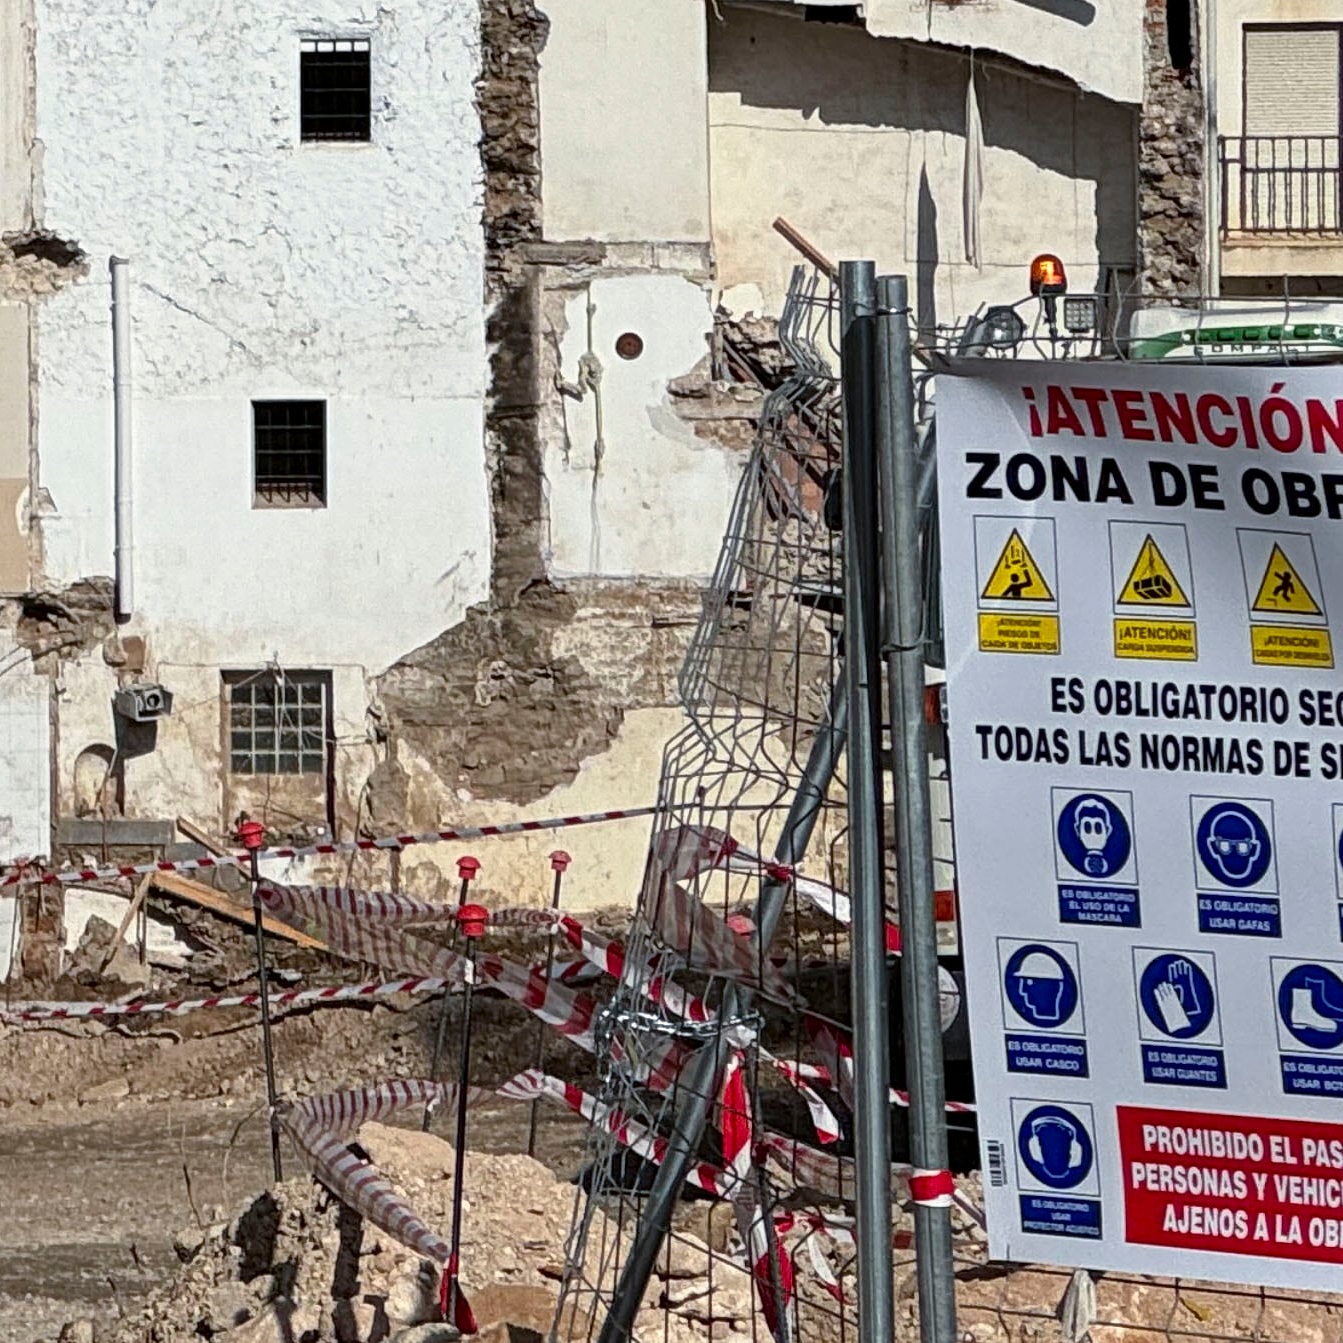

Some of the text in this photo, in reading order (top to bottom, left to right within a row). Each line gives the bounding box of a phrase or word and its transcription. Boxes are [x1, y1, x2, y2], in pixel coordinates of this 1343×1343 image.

[965, 452, 1134, 504] ZONA
[1148, 460, 1225, 510] DE
[1119, 625, 1192, 641] ¡ATENCIÓN!
[1051, 677, 1085, 714] ES
[1094, 679, 1289, 725] OBLIGATORIO
[975, 724, 1343, 780] TODAS LAS NORMAS DE S
[1200, 899, 1278, 915] ES OBLIGATORIO
[1209, 917, 1270, 932] USAR GAFAS
[1022, 1041, 1084, 1056] OBLIGATORIO
[1045, 1058, 1079, 1071] CASCO
[1142, 1124, 1263, 1161] PROHIBIDO
[1269, 1135, 1297, 1164] EL
[1131, 1162, 1343, 1208] PERSONAS Y VEHIC
[1163, 1204, 1343, 1248] AJENOS A LA OB
